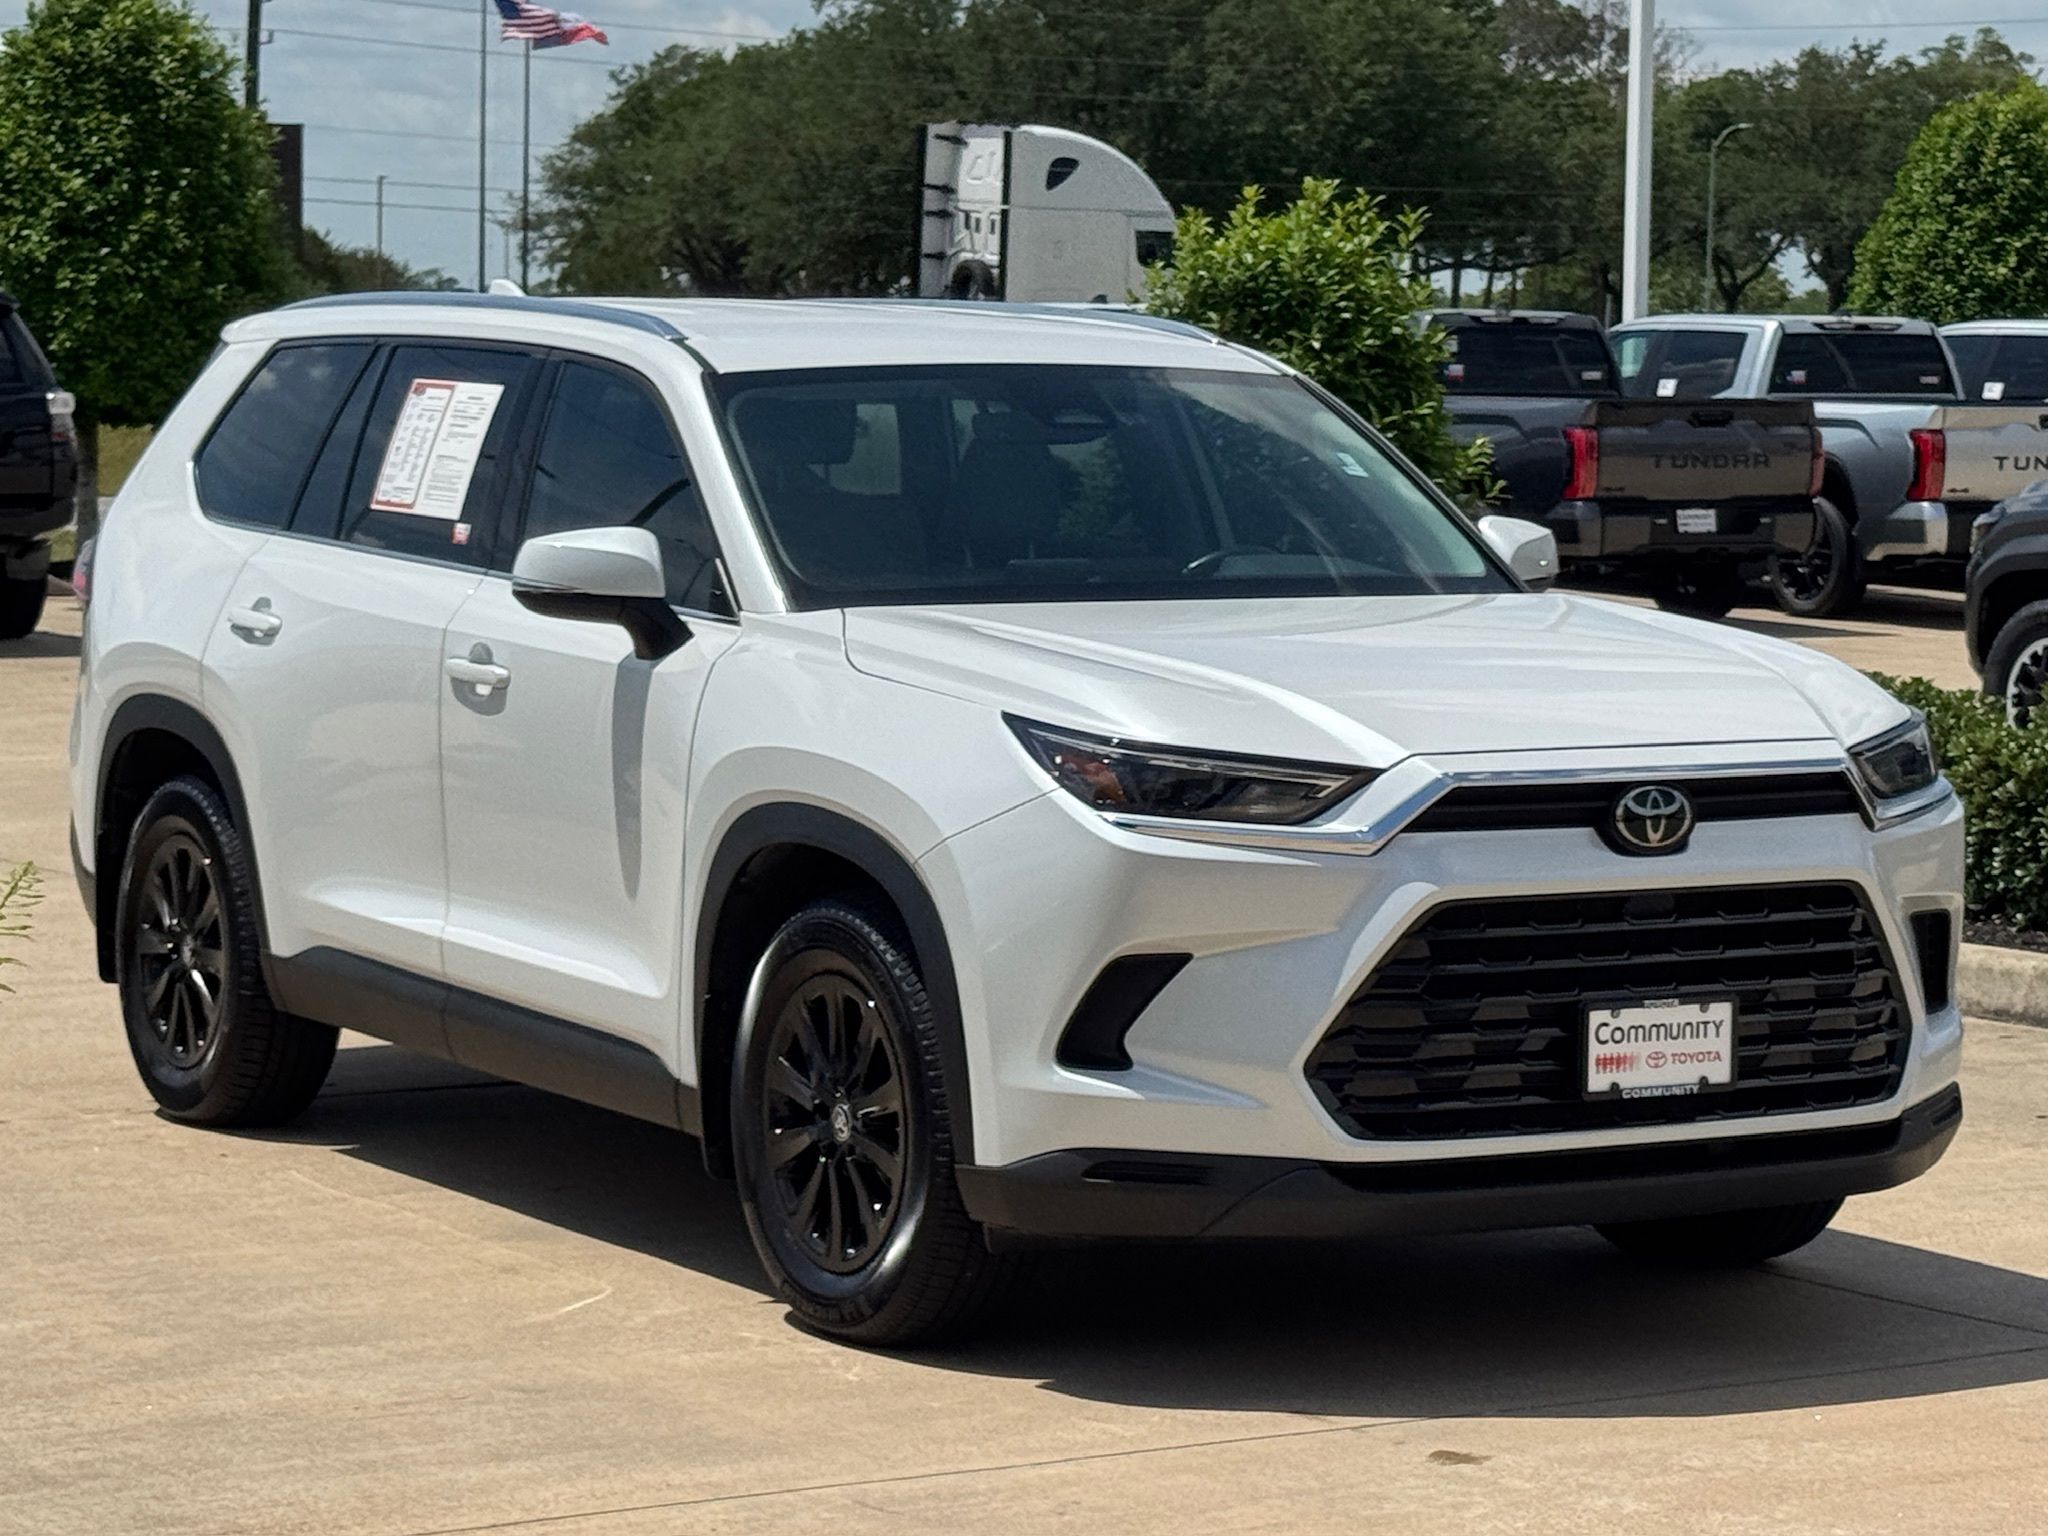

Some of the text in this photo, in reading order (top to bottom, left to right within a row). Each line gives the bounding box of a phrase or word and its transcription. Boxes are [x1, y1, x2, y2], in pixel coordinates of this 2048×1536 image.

[1652, 453, 1771, 469] TUNDRA
[1992, 456, 2048, 471] TUN
[1671, 1050, 1722, 1065] TOYOTA
[1621, 1085, 1699, 1099] COMMUNITY
